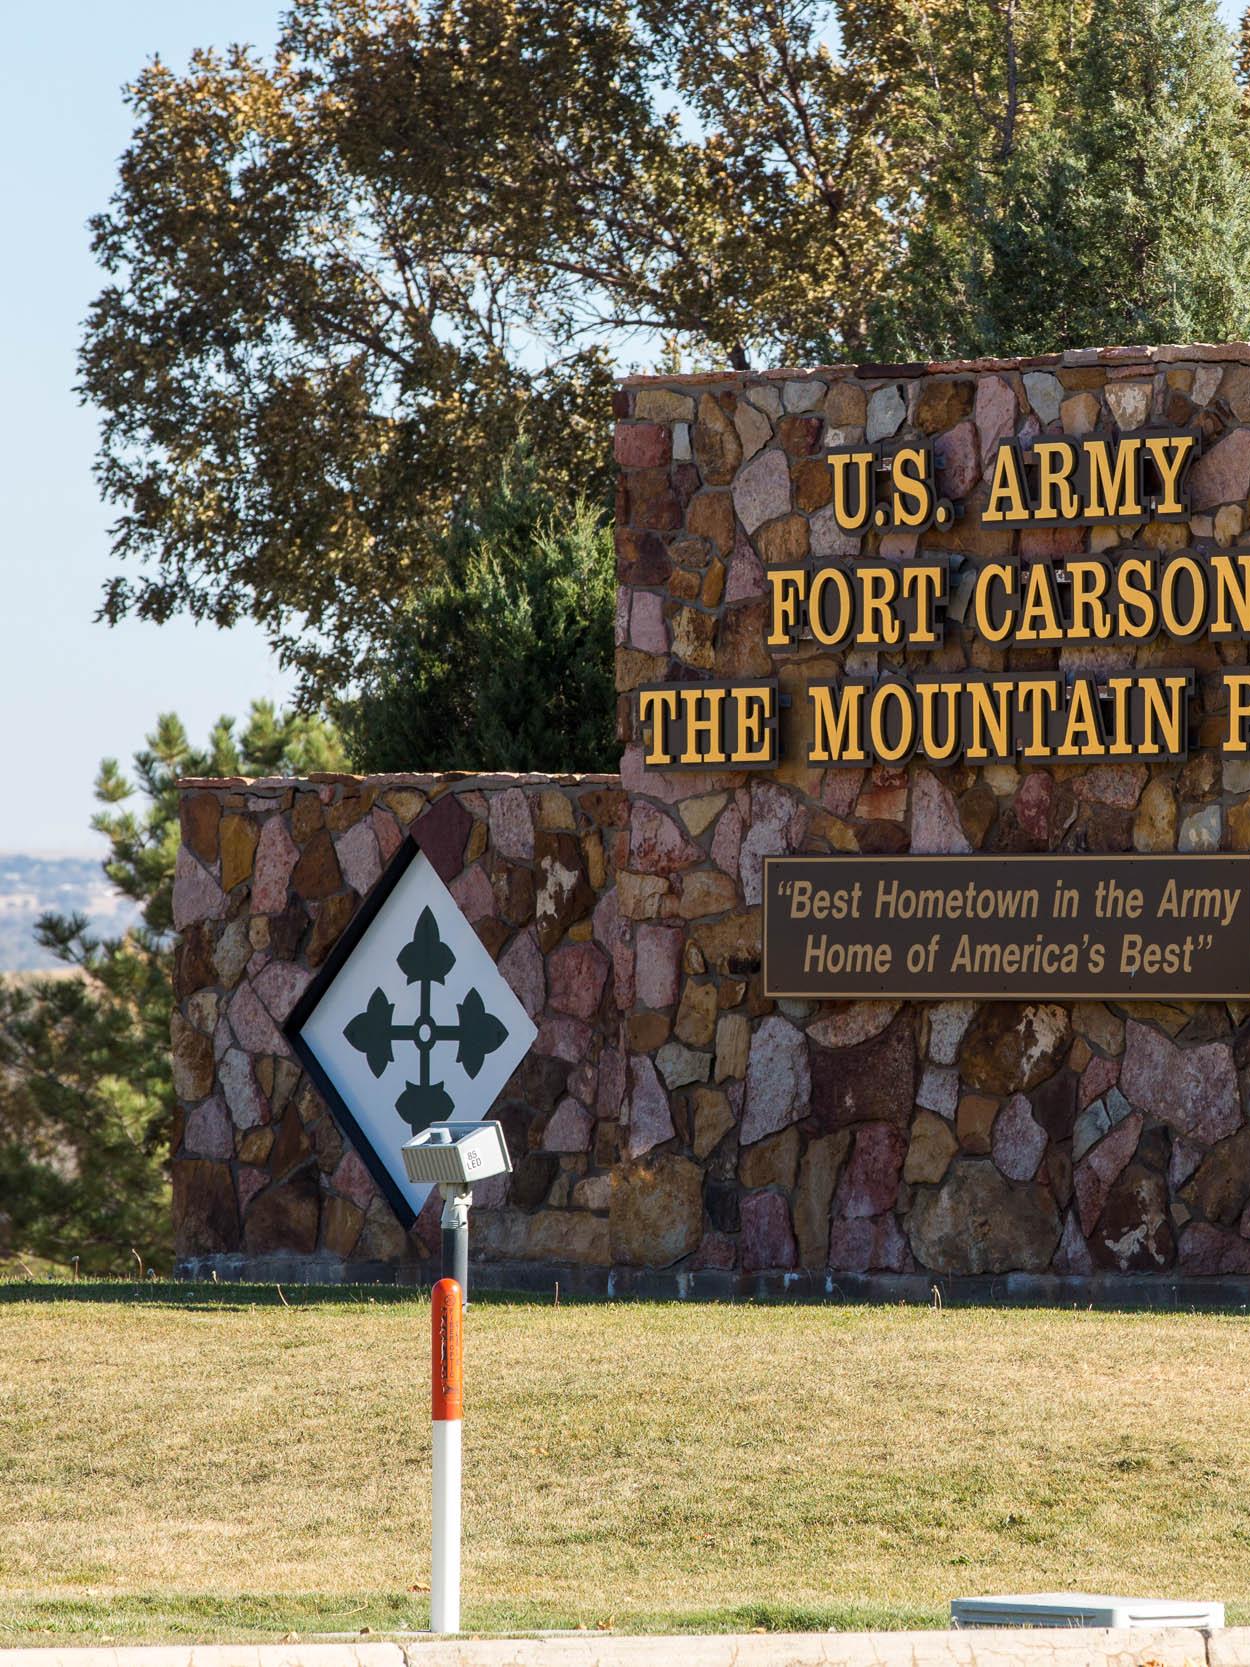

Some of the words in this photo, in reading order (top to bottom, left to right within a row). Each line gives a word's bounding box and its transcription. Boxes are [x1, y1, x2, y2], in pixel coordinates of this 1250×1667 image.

[828, 450, 945, 529] U.S.
[983, 438, 1192, 521] ARMY
[767, 566, 942, 645] FORT
[640, 687, 770, 764] THE
[809, 676, 1186, 761] MOUNTAIN
[875, 879, 1039, 919] Hometown
[1052, 879, 1079, 918] in
[1095, 879, 1144, 919] the
[1157, 879, 1241, 926] Army
[804, 934, 892, 973] Home
[906, 934, 940, 973] of
[950, 934, 1105, 974] America’s
[466, 1157, 481, 1170] LED
[467, 1150, 477, 1160] 85
